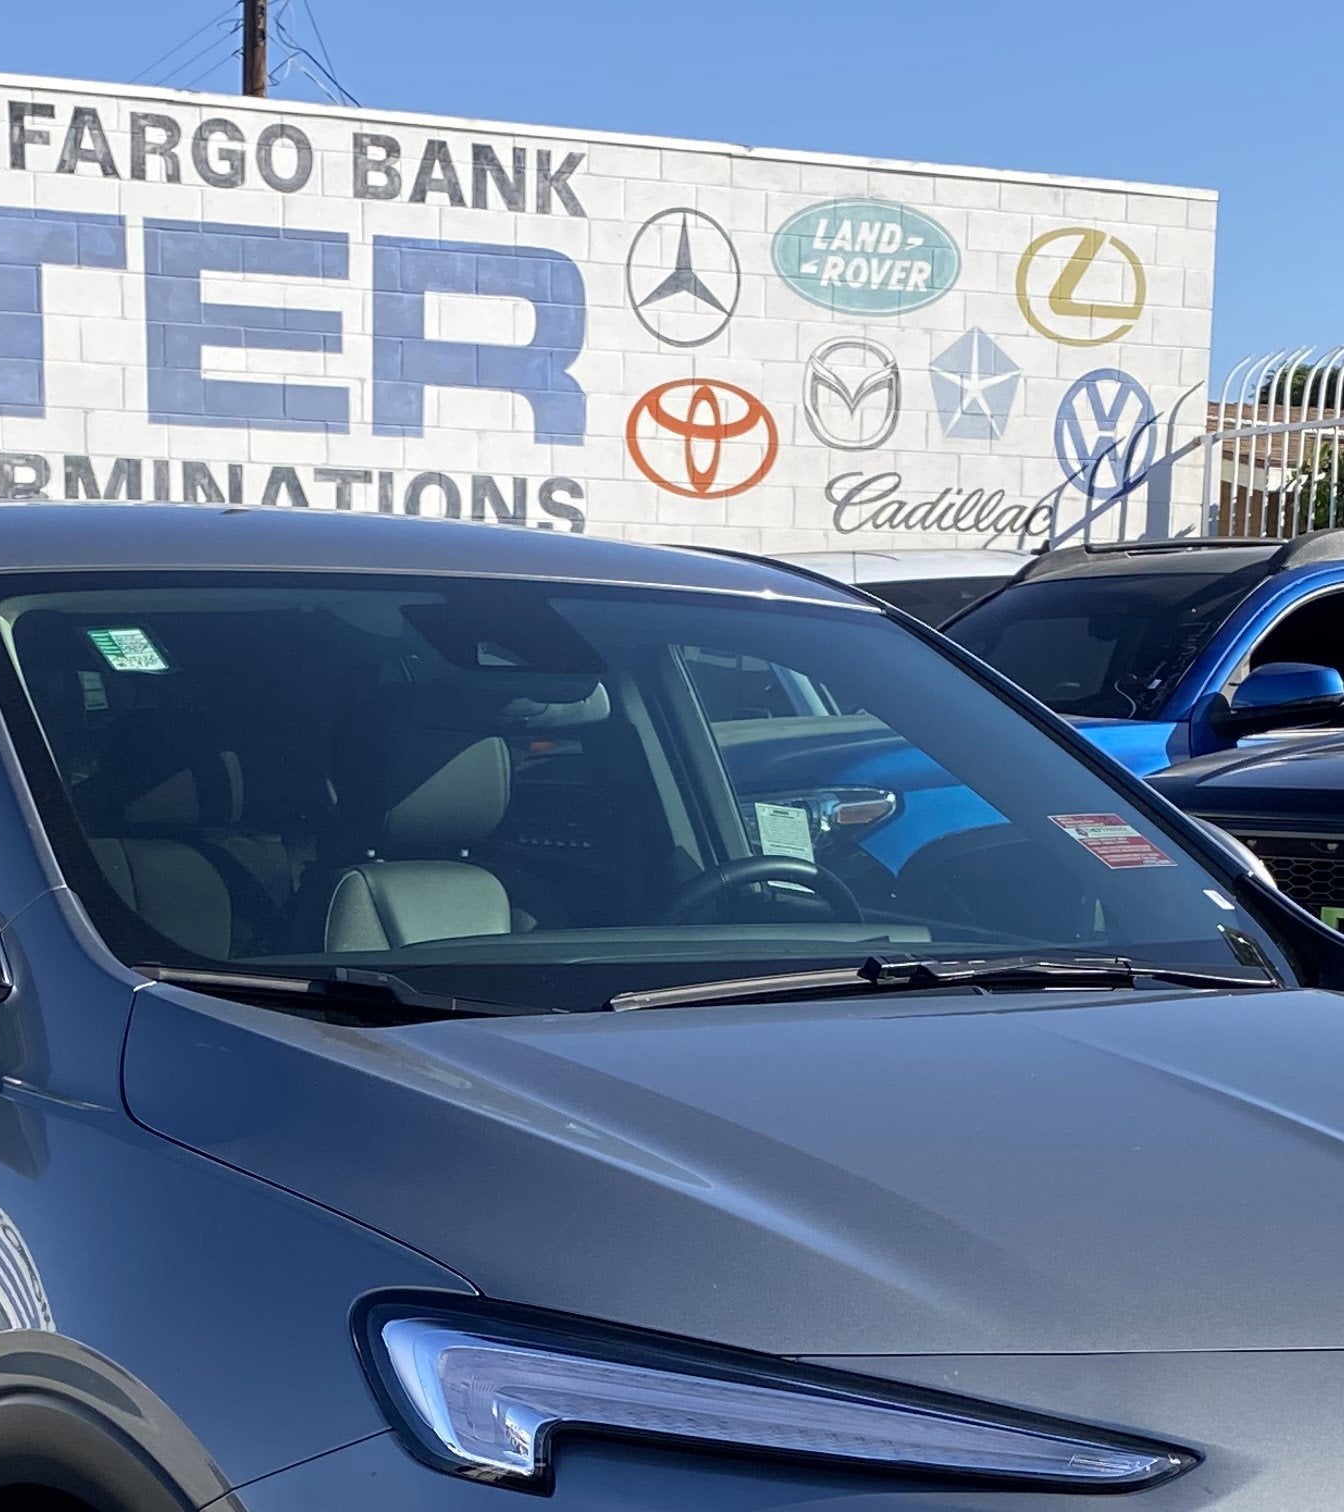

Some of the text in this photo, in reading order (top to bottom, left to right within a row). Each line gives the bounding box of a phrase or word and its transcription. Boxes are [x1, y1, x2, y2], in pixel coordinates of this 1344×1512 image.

[7, 99, 315, 194] FARGO
[352, 132, 588, 217] BANK
[825, 471, 1056, 537] Cadillac
